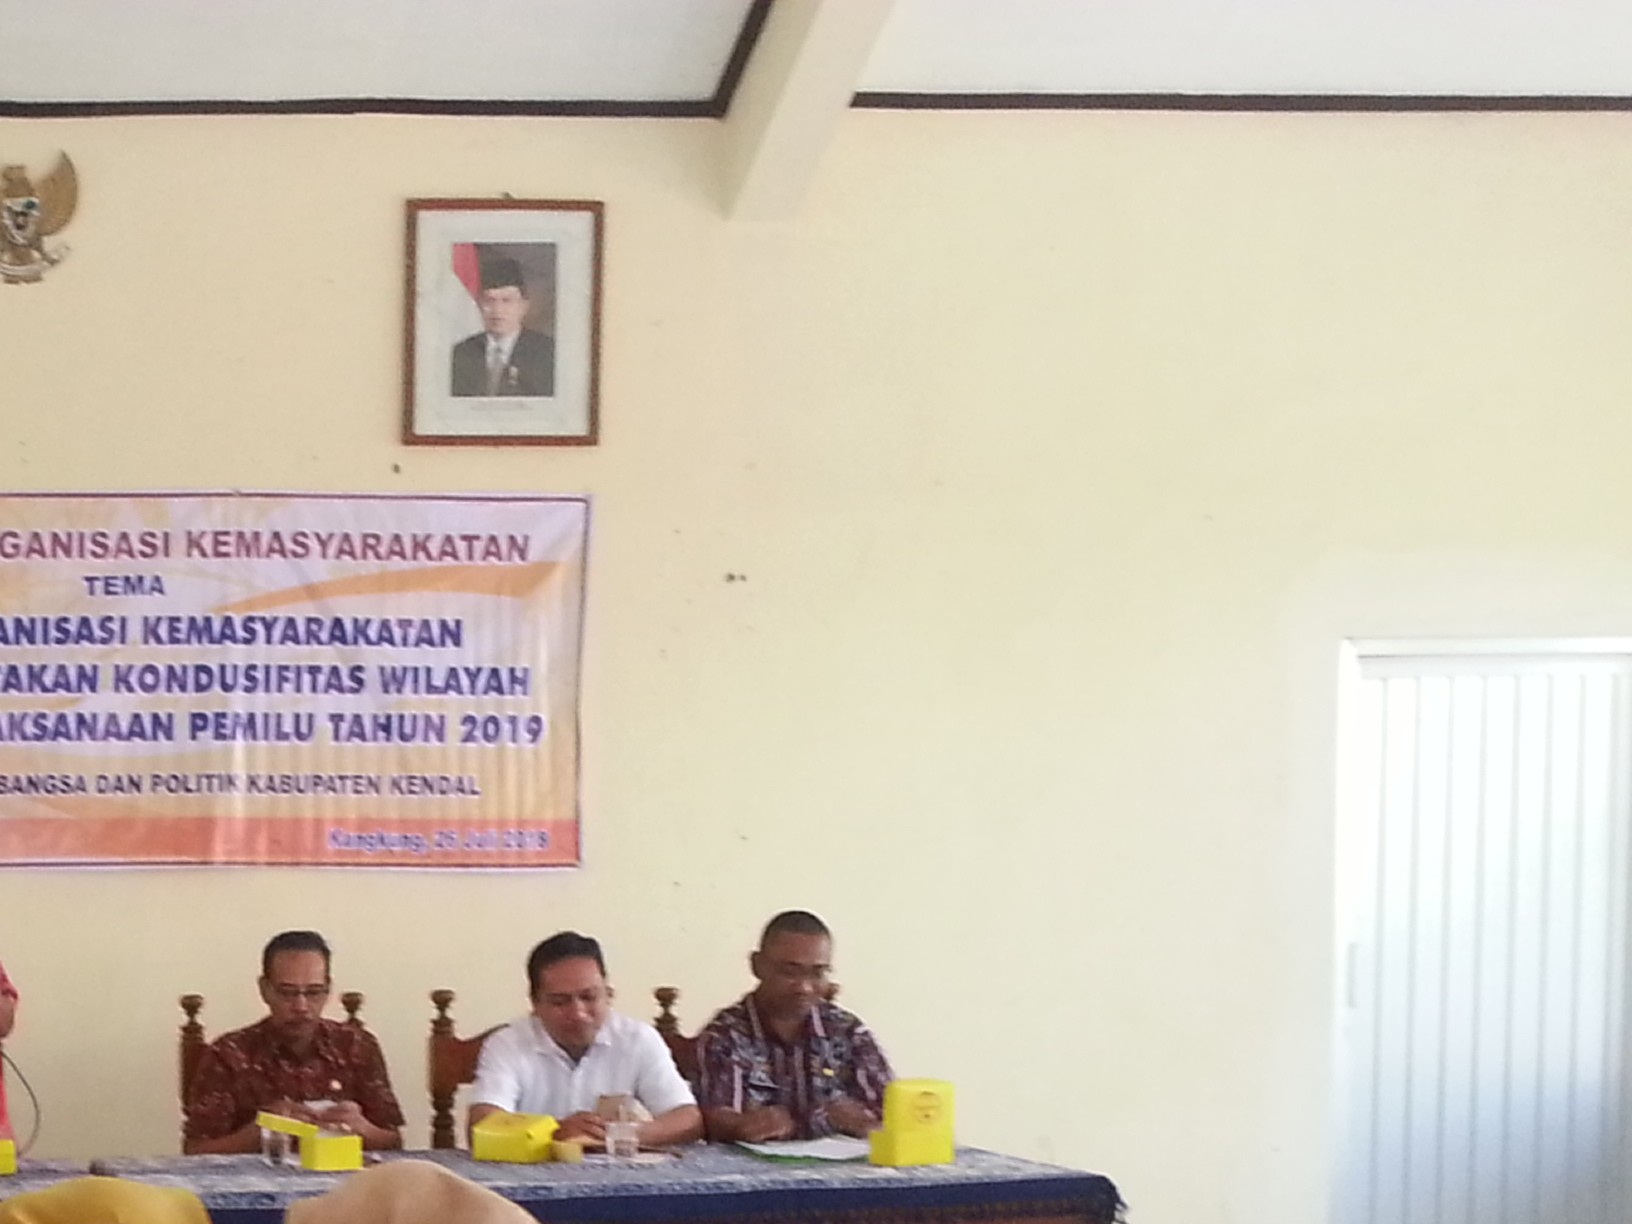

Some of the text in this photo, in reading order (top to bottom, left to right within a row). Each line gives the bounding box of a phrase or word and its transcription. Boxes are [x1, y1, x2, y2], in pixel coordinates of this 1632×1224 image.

[186, 530, 531, 563] KEMASYARAKATAN
[83, 575, 166, 597] TEMA
[141, 615, 463, 648] KEMASYARAKATAN
[113, 663, 366, 695] KONDUSIFITAS
[378, 664, 531, 697] WILAYAH
[188, 711, 315, 742] PEMILU
[327, 713, 447, 744] TAHUN
[459, 714, 545, 745] 2019
[95, 774, 143, 796] DAN
[149, 774, 240, 796] POLITIK
[246, 774, 382, 797] KABUPATEN
[389, 775, 482, 797] KENDAL
